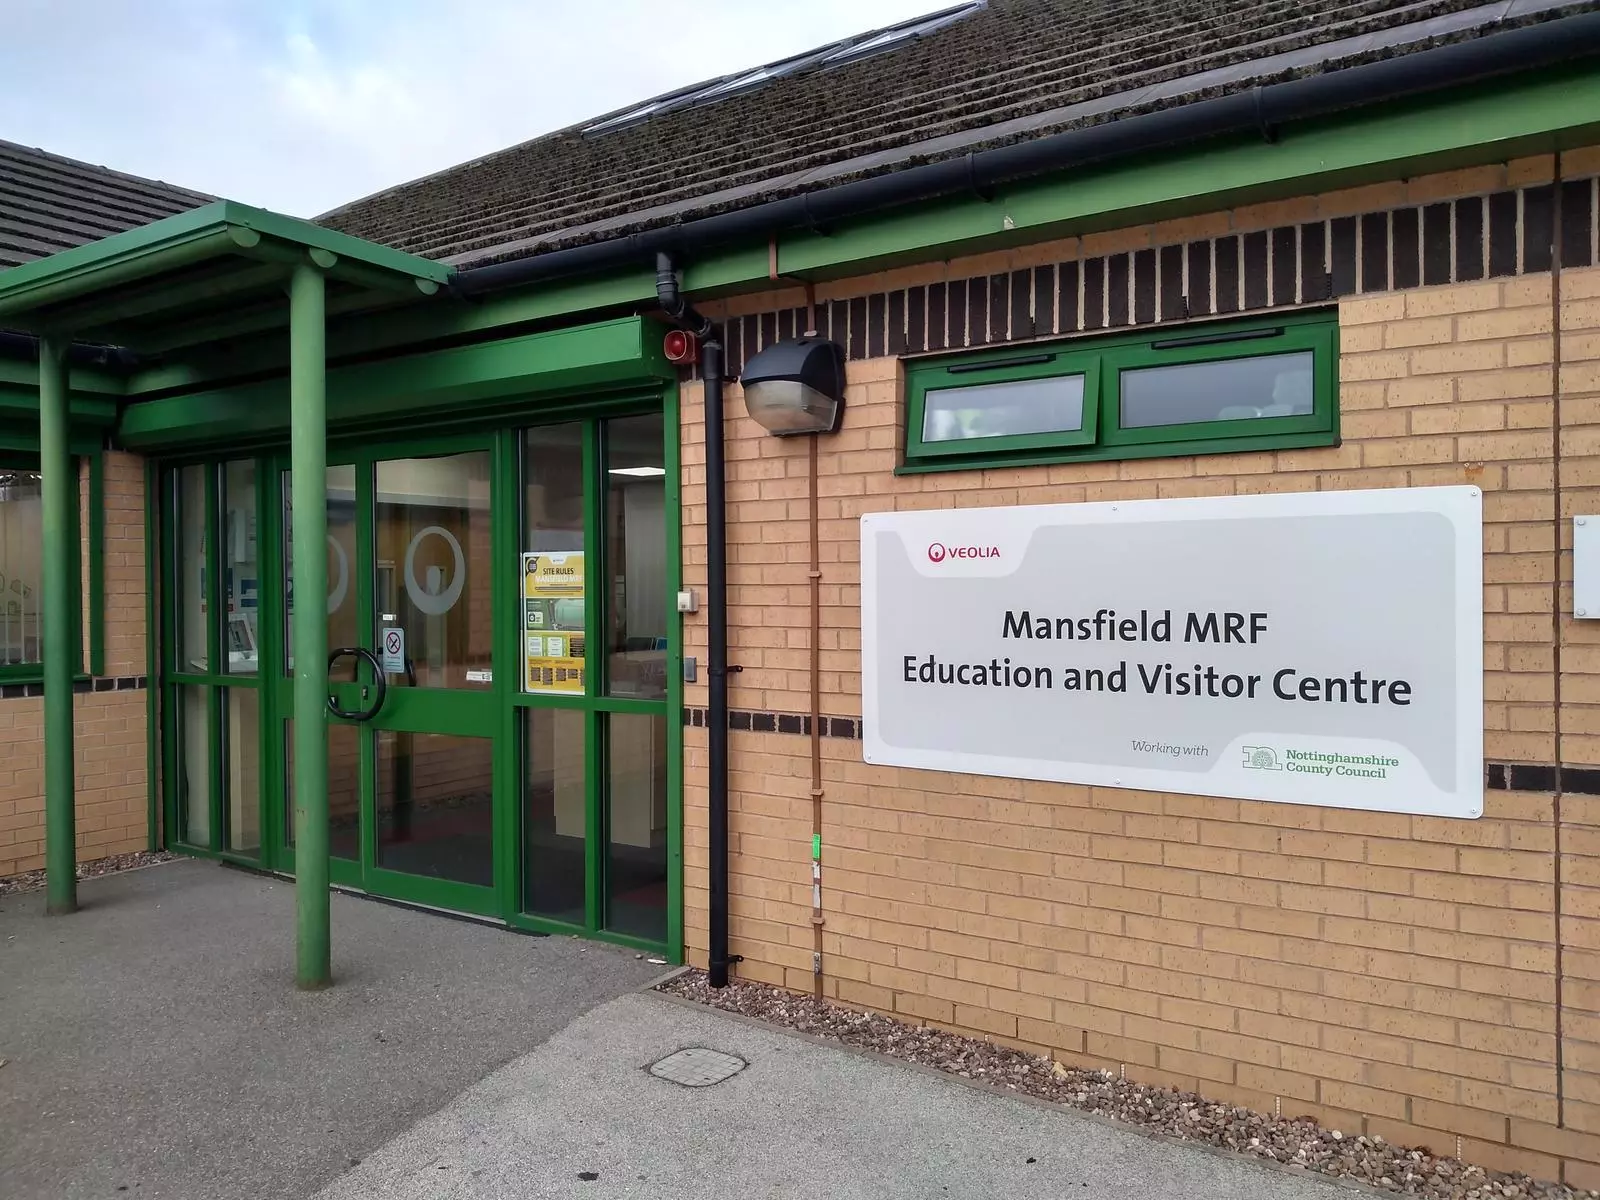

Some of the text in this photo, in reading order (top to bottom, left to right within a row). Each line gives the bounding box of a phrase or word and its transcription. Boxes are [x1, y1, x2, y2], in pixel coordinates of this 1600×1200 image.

[948, 546, 1001, 559] VEOLIA
[542, 567, 574, 575] SITE RULES
[1003, 608, 1268, 644] Mansfield MRF
[904, 654, 1412, 706] Education and Visitor Centre
[1131, 740, 1209, 757] Working with
[1286, 749, 1399, 767] Nottinghamshire
[1286, 761, 1387, 779] County Council
